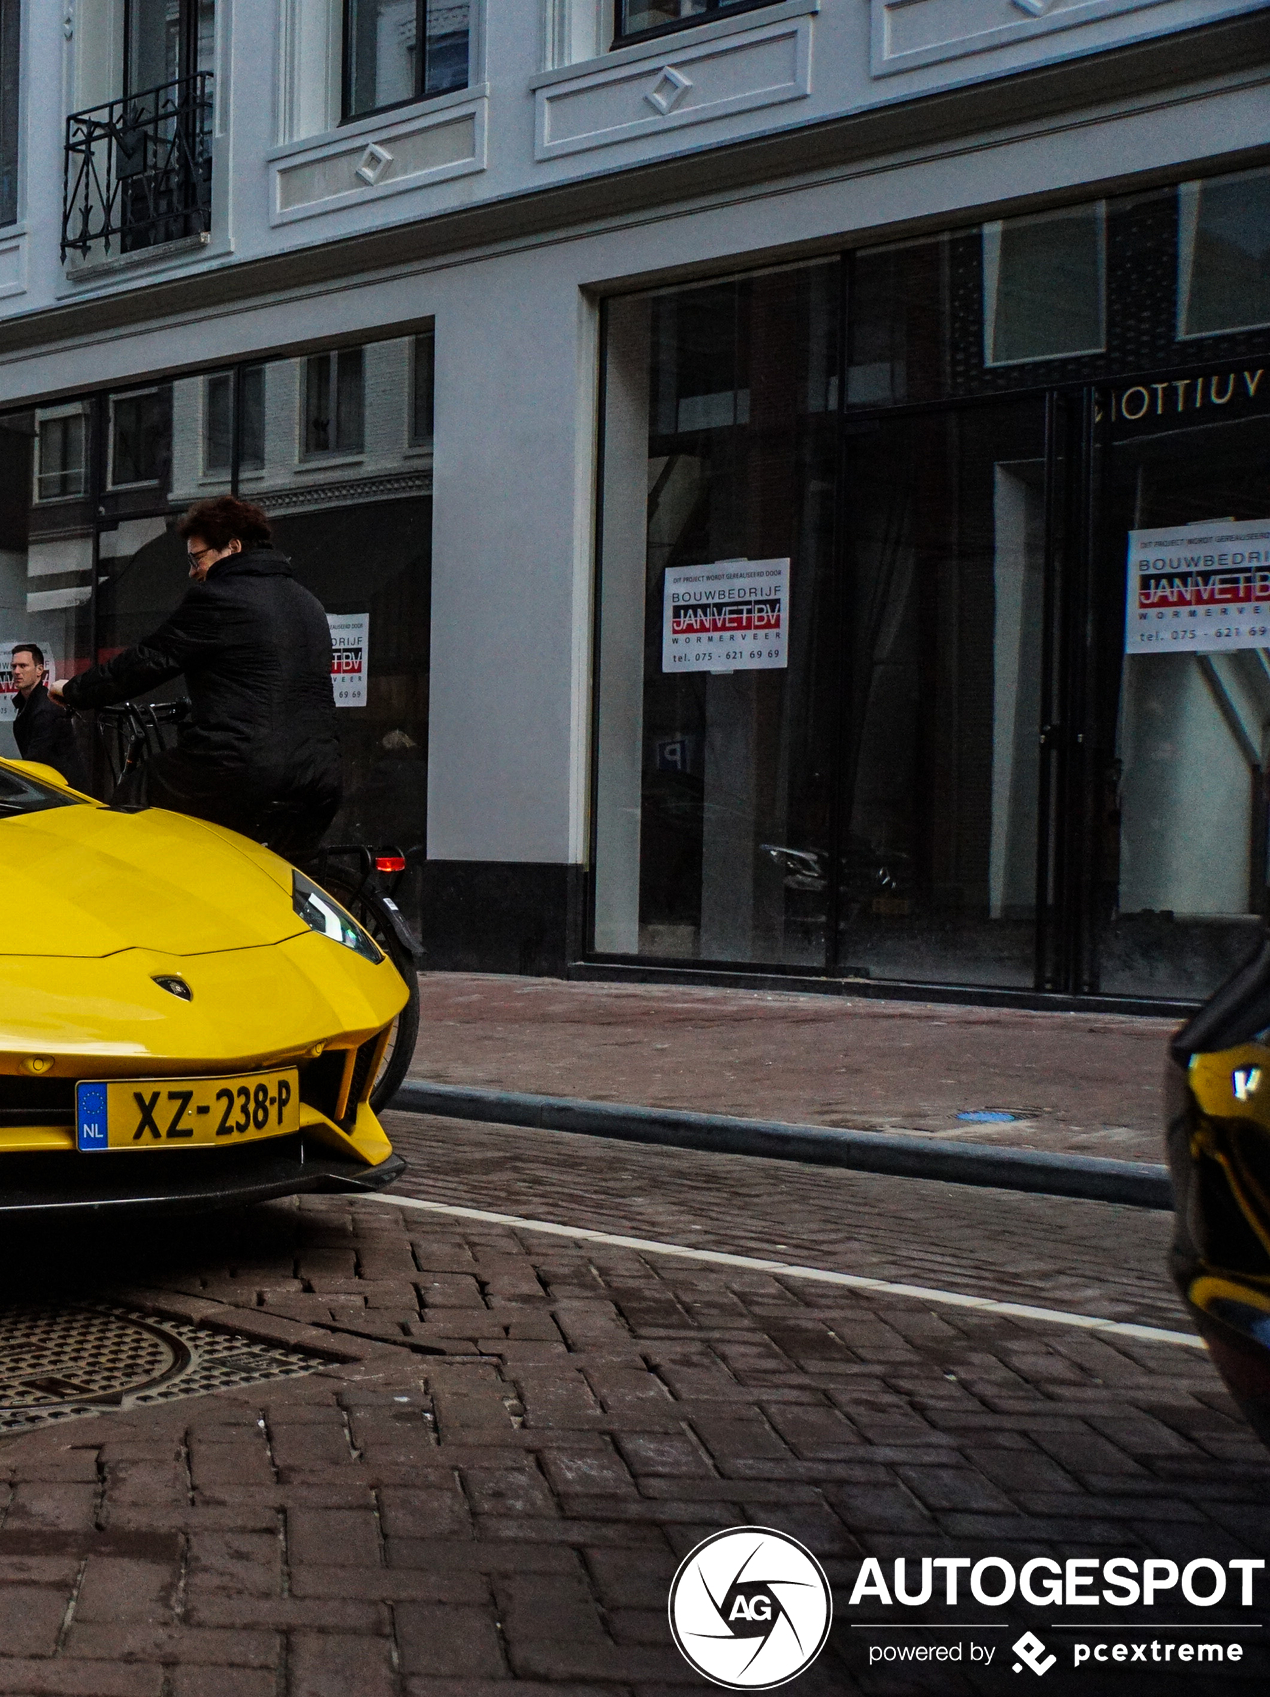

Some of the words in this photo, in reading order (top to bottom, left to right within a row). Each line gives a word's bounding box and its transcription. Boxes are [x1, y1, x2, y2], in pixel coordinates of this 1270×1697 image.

[683, 575, 704, 583] PROJECT
[726, 571, 764, 580] GEREALISEERD
[672, 585, 781, 603] BOUWBEDRIJF
[1139, 577, 1192, 604] JAN
[1197, 573, 1252, 600] VET
[673, 607, 710, 630] JAN
[713, 605, 752, 628] VET
[754, 603, 780, 626] BV
[1139, 606, 1270, 620] WORMERVE
[672, 632, 781, 644] WORMERVEER
[1139, 632, 1164, 641] tel.
[1170, 630, 1196, 640] 075
[1214, 627, 1240, 638] 621
[1248, 626, 1268, 637] 69
[342, 652, 362, 670] BV
[673, 654, 691, 662] tel.
[695, 653, 712, 661] 075
[725, 651, 743, 660] 621
[749, 650, 763, 659] 69
[767, 649, 780, 658] 69
[351, 690, 361, 698] 69
[132, 1079, 291, 1140] XZ-238-P
[83, 1123, 104, 1138] NL
